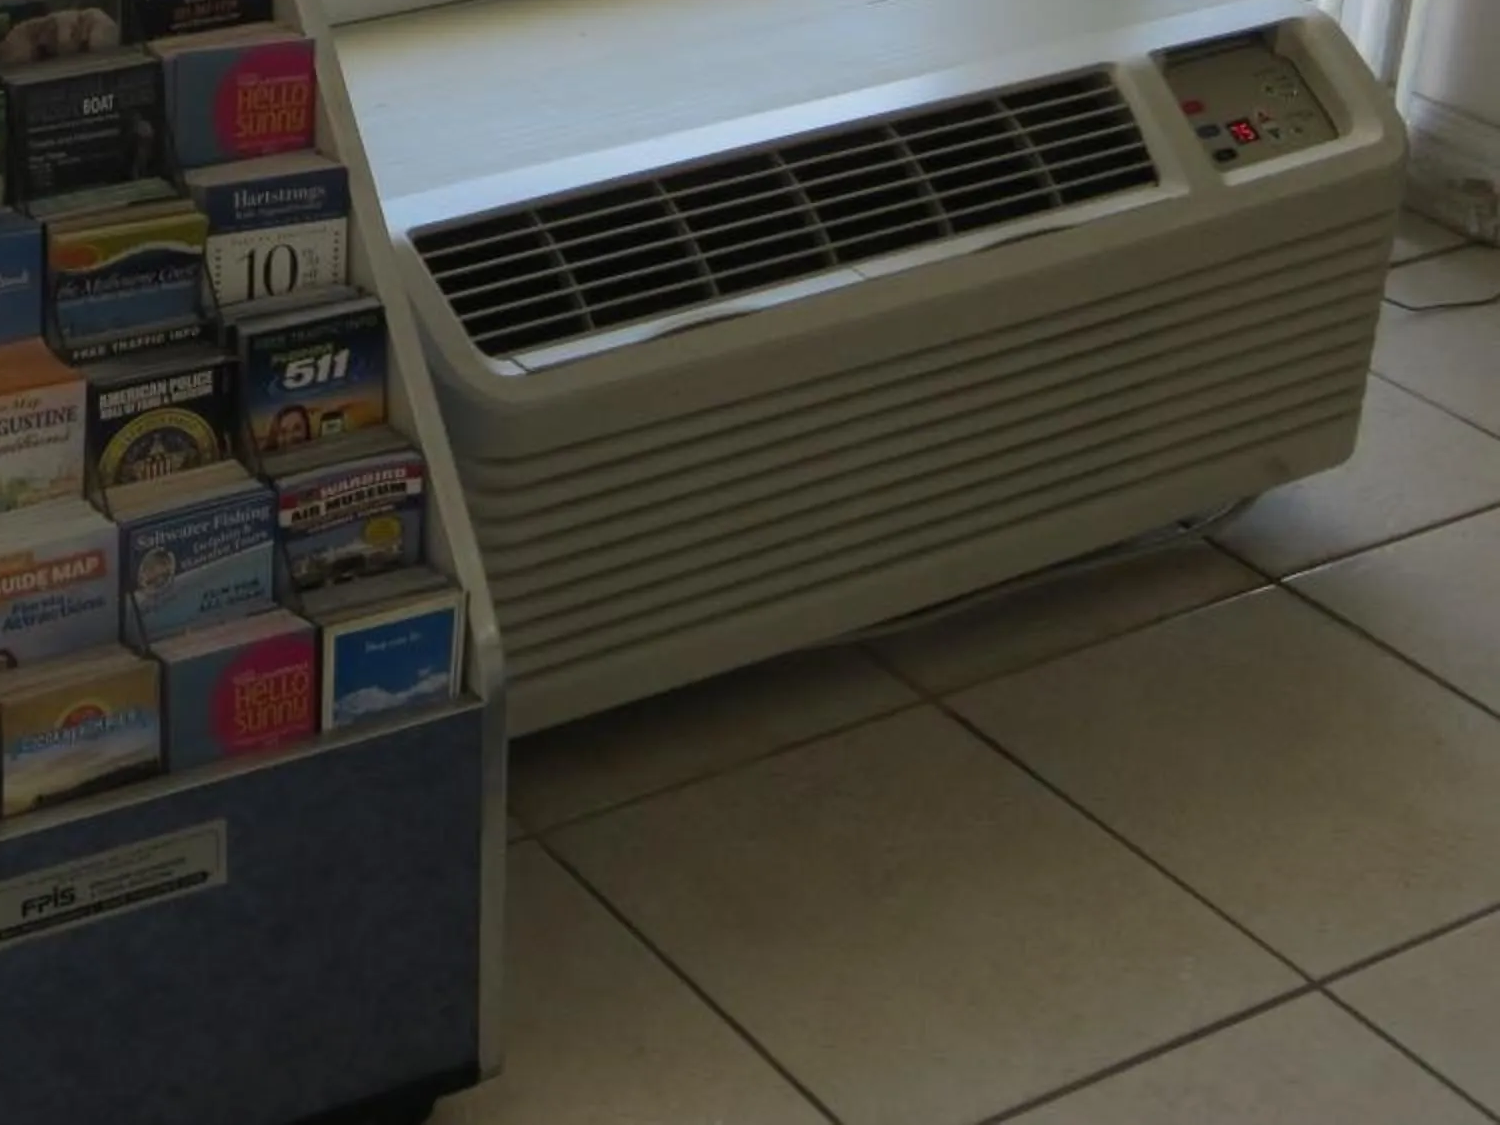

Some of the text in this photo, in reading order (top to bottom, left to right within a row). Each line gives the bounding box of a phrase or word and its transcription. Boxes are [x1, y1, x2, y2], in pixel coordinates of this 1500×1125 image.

[83, 93, 115, 116] BOAT
[237, 243, 299, 301] 10
[282, 348, 351, 391] 511
[291, 481, 408, 523] AIR MUSEUM
[137, 504, 271, 550] Saltwater Fishing
[52, 555, 100, 585] MAP
